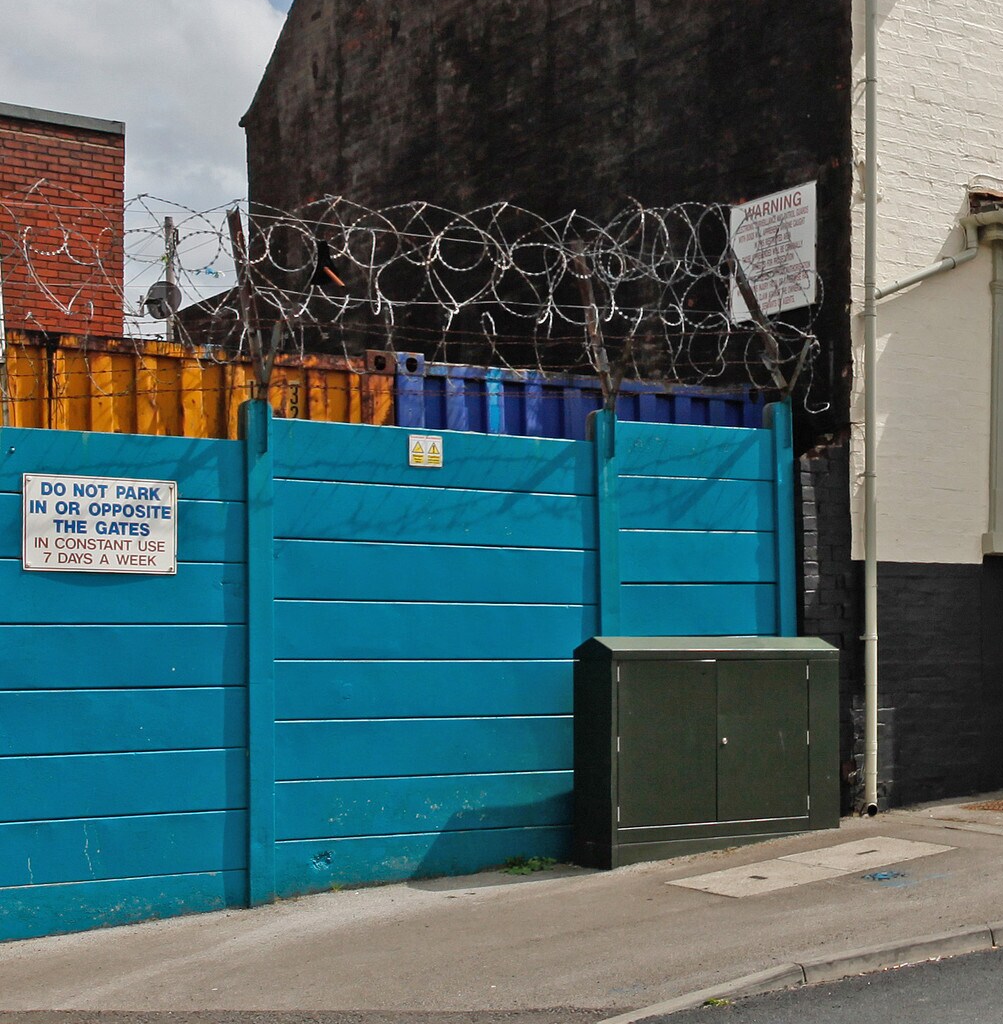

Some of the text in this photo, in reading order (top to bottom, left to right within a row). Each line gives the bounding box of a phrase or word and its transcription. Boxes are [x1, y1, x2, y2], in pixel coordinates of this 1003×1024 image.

[744, 191, 802, 221] WARNING
[41, 481, 160, 501] DO NOT PARK
[29, 500, 172, 520] IN OR OPPOSITE
[53, 519, 150, 537] THE GATES
[34, 537, 166, 552] IN CONSTANT USE
[43, 552, 157, 566] 7 DAYS A WEEK
